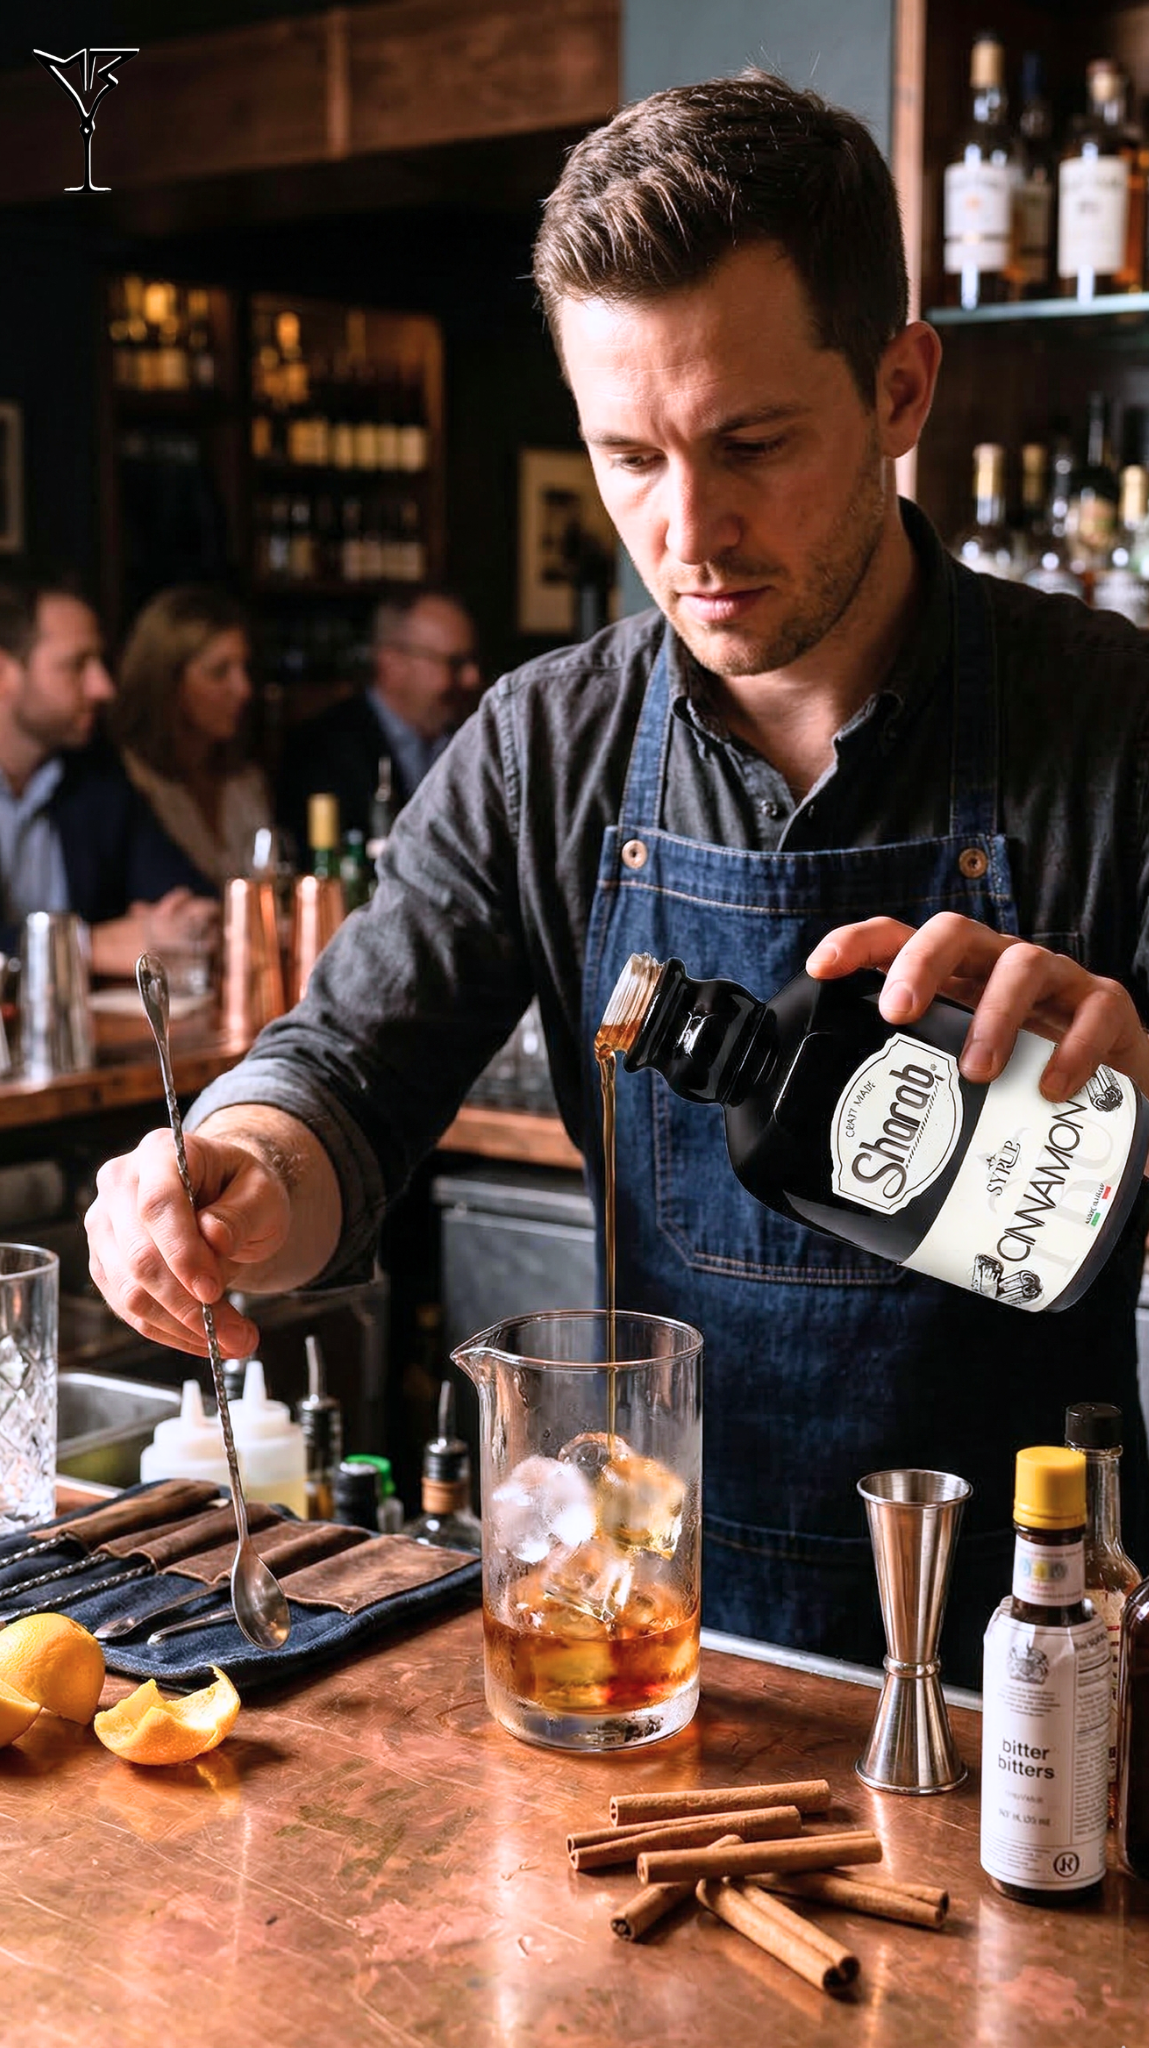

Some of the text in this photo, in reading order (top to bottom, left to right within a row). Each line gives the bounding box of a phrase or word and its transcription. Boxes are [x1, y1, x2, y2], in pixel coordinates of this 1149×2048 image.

[851, 1063, 937, 1199] Sharab
[986, 1139, 1021, 1197] SYRUP
[996, 1100, 1089, 1262] CINNAMON
[997, 1754, 1056, 1780] bitters
[1002, 1737, 1050, 1761] bitter
